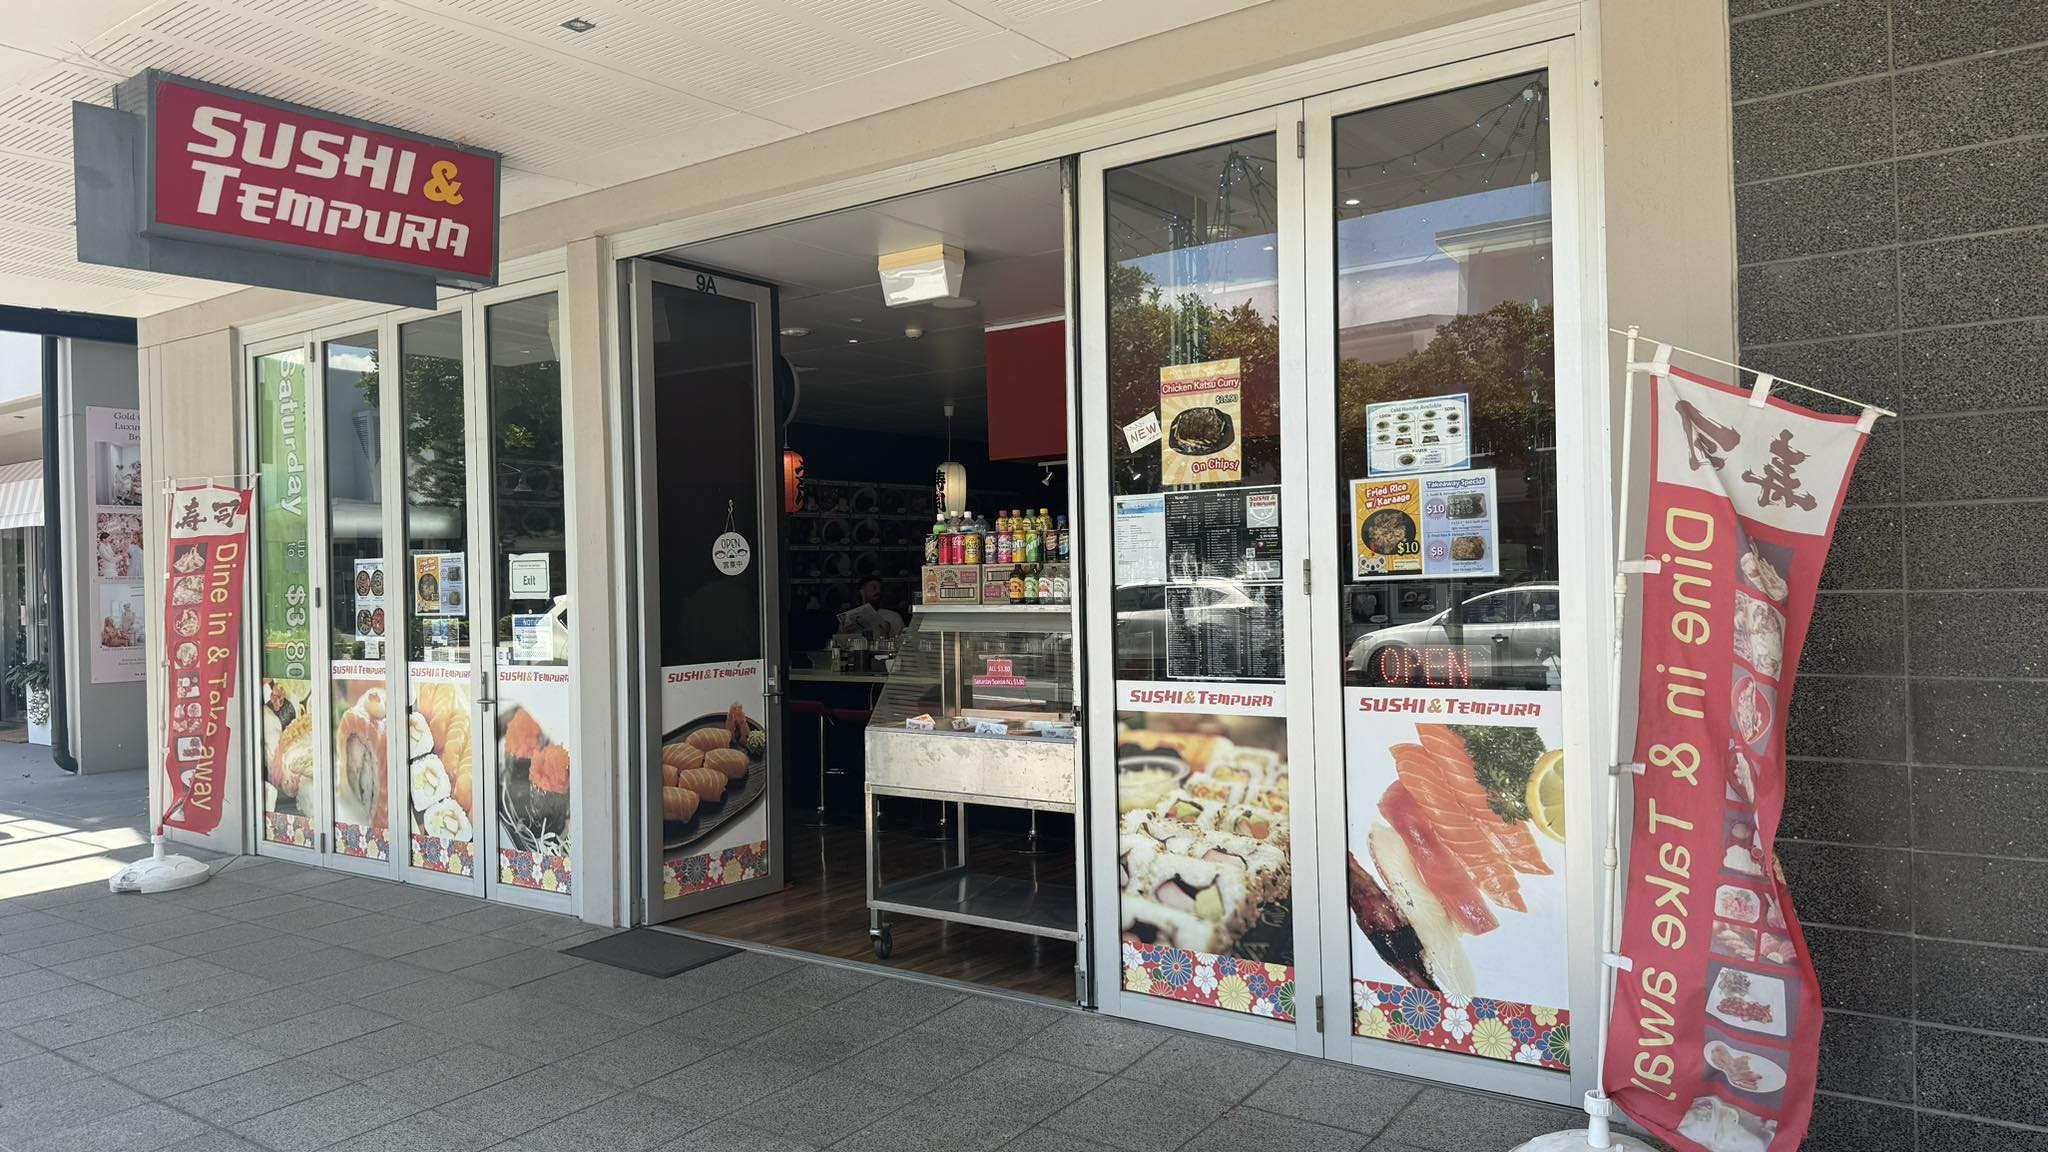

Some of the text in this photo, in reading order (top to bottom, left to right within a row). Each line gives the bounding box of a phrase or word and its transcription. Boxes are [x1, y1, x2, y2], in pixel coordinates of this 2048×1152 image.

[187, 106, 464, 206] SUSHI &
[696, 274, 718, 295] 9A
[1162, 378, 1240, 394] Chicken Katsu Curry
[113, 412, 135, 420] Gold
[279, 353, 305, 516] Saturday
[1130, 423, 1157, 443] NEW
[1192, 458, 1239, 473] On Chips!
[1366, 483, 1408, 498] Fried Rice
[1426, 477, 1485, 489] Takeaway Special
[1366, 494, 1411, 508] w/Karaage
[1426, 504, 1445, 514] $10
[288, 542, 297, 557] to
[298, 540, 306, 558] up
[721, 538, 741, 549] OPEN
[1397, 541, 1419, 554] $10
[1431, 546, 1444, 557] $8
[210, 543, 238, 603] Dine
[523, 576, 536, 586] Exit
[208, 612, 232, 635] in
[207, 646, 230, 665] &
[332, 665, 353, 675] SUSHI
[353, 665, 358, 674] &
[410, 667, 434, 678] SUSHI
[435, 668, 440, 678] &
[1381, 647, 1469, 687] OPEN
[499, 671, 526, 682] SUSHI
[527, 671, 533, 682] &
[667, 670, 704, 683] SUSHI
[704, 669, 712, 680] &
[1129, 689, 1183, 704] SUSHI
[1184, 690, 1196, 704] &
[1359, 697, 1426, 713] SUSHI
[1427, 698, 1442, 714] &
[191, 746, 215, 811] away
